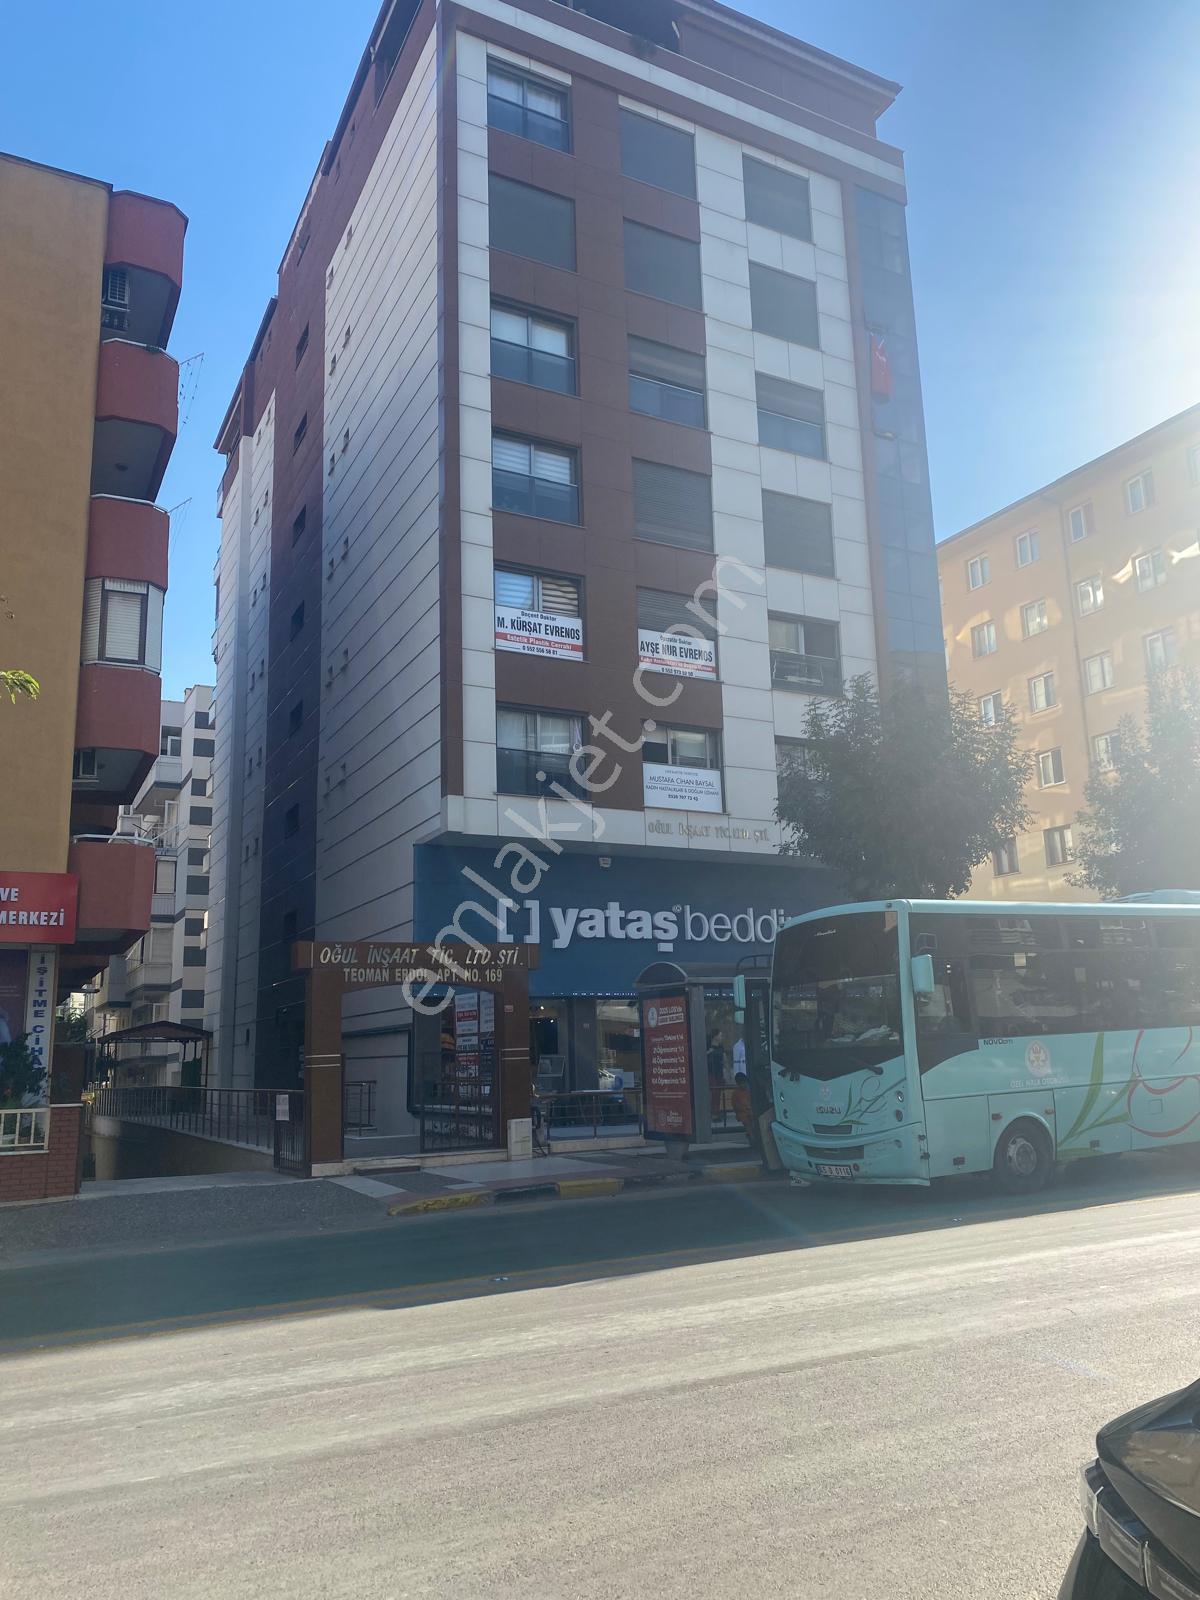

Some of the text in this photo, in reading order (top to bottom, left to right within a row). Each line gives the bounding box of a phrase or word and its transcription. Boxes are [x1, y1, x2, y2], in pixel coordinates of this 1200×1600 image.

[520, 610, 557, 622] Doçent Doktor
[496, 616, 580, 641] M. KÜRŞAT EVRENOS
[506, 634, 572, 650] Estetik Plastik Cerrahi
[640, 640, 713, 662] AYŞE NUR EVRENOS
[649, 775, 675, 784] MUSTAFA
[695, 780, 715, 788] BAYSAL
[648, 820, 674, 835] OĞUL
[0, 887, 19, 901] VE
[548, 901, 792, 953] yataş beddi
[320, 943, 358, 964] OĞUL
[367, 944, 420, 968] İNŞAAT
[343, 967, 390, 982] TEOMAN
[437, 968, 459, 982] APT.
[485, 967, 503, 983] 169
[30, 952, 49, 1072] İŞİTME CİHA
[816, 1105, 841, 1115] ISUZU
